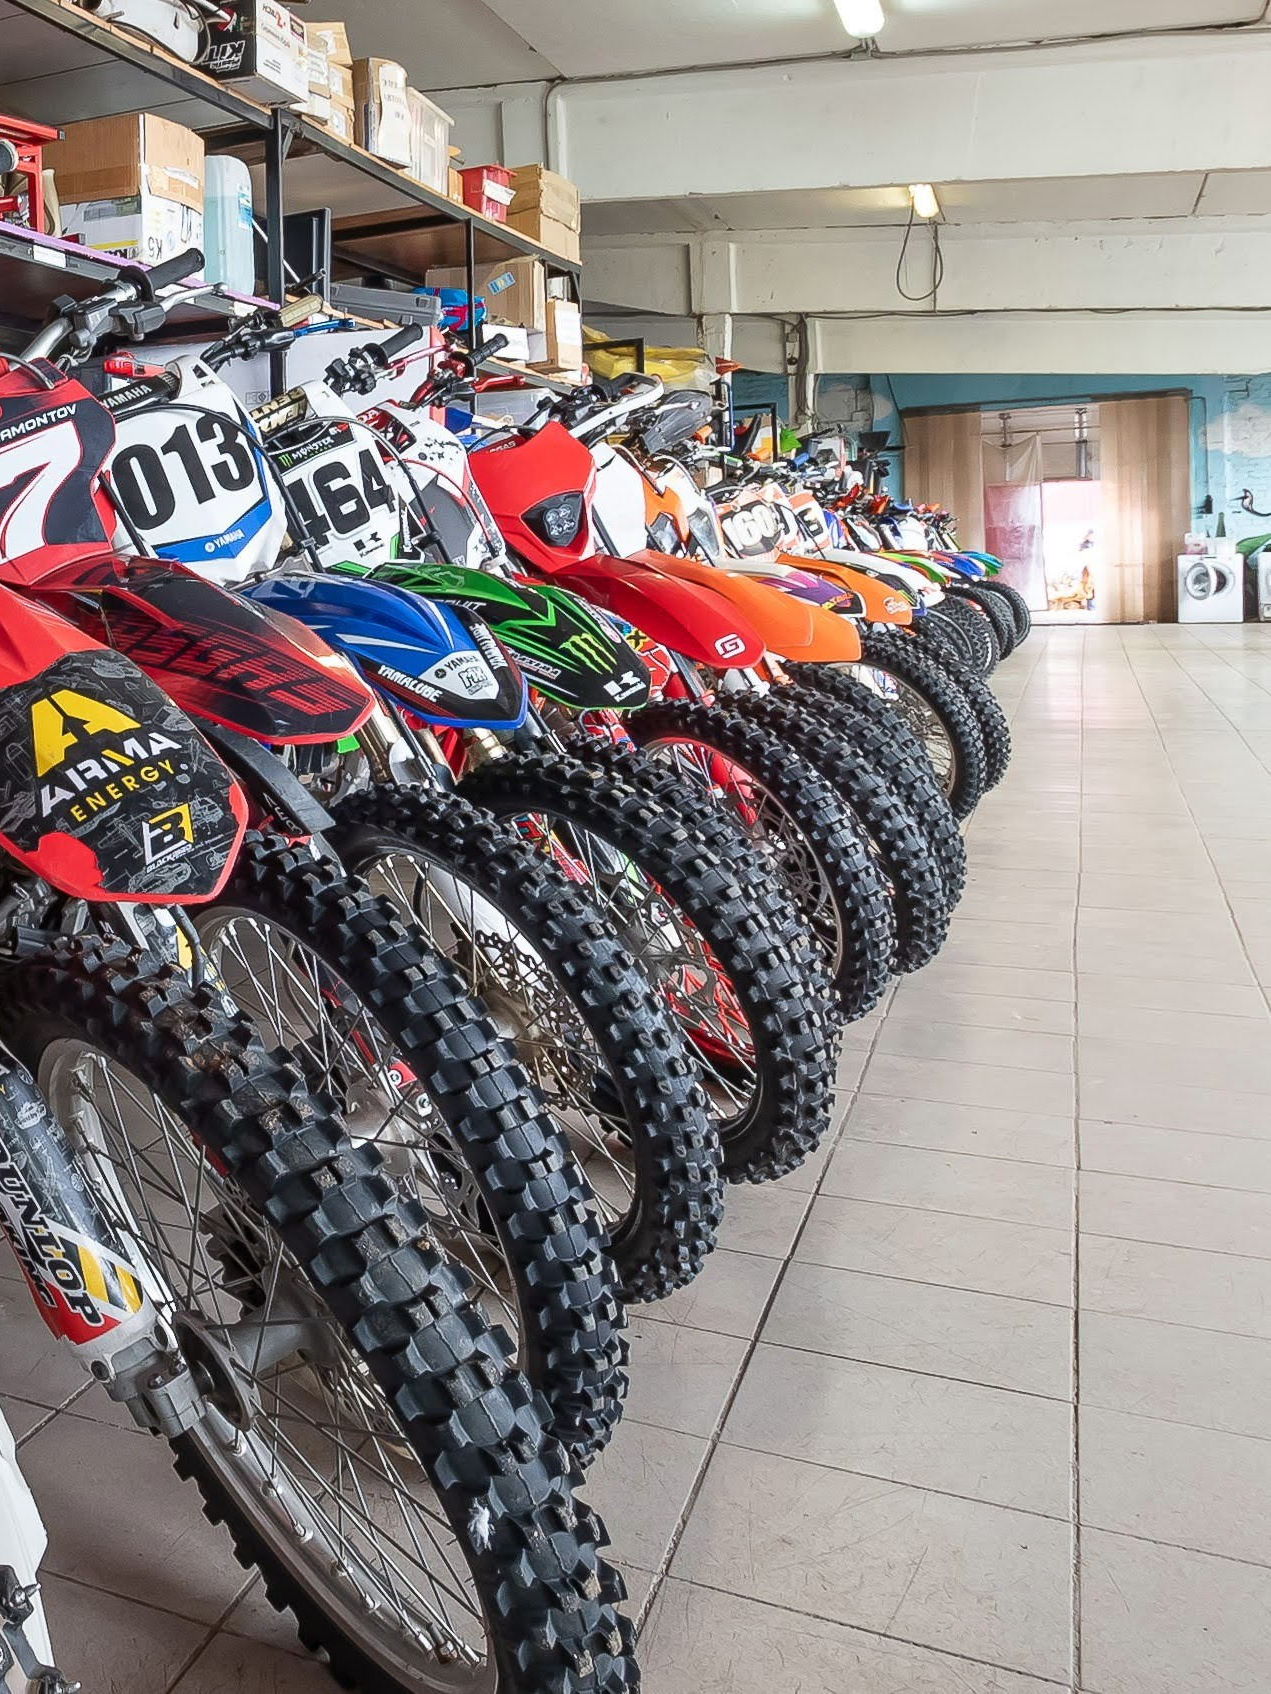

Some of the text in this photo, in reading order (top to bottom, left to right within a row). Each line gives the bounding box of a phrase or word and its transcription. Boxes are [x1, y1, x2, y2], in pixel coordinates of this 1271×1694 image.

[101, 383, 152, 411] YAMAHA
[111, 410, 255, 531] 013
[213, 528, 245, 549] YAMAHA
[377, 664, 443, 703] YAMALUBE
[40, 731, 182, 818] ARMA
[69, 758, 174, 823] ENERGY
